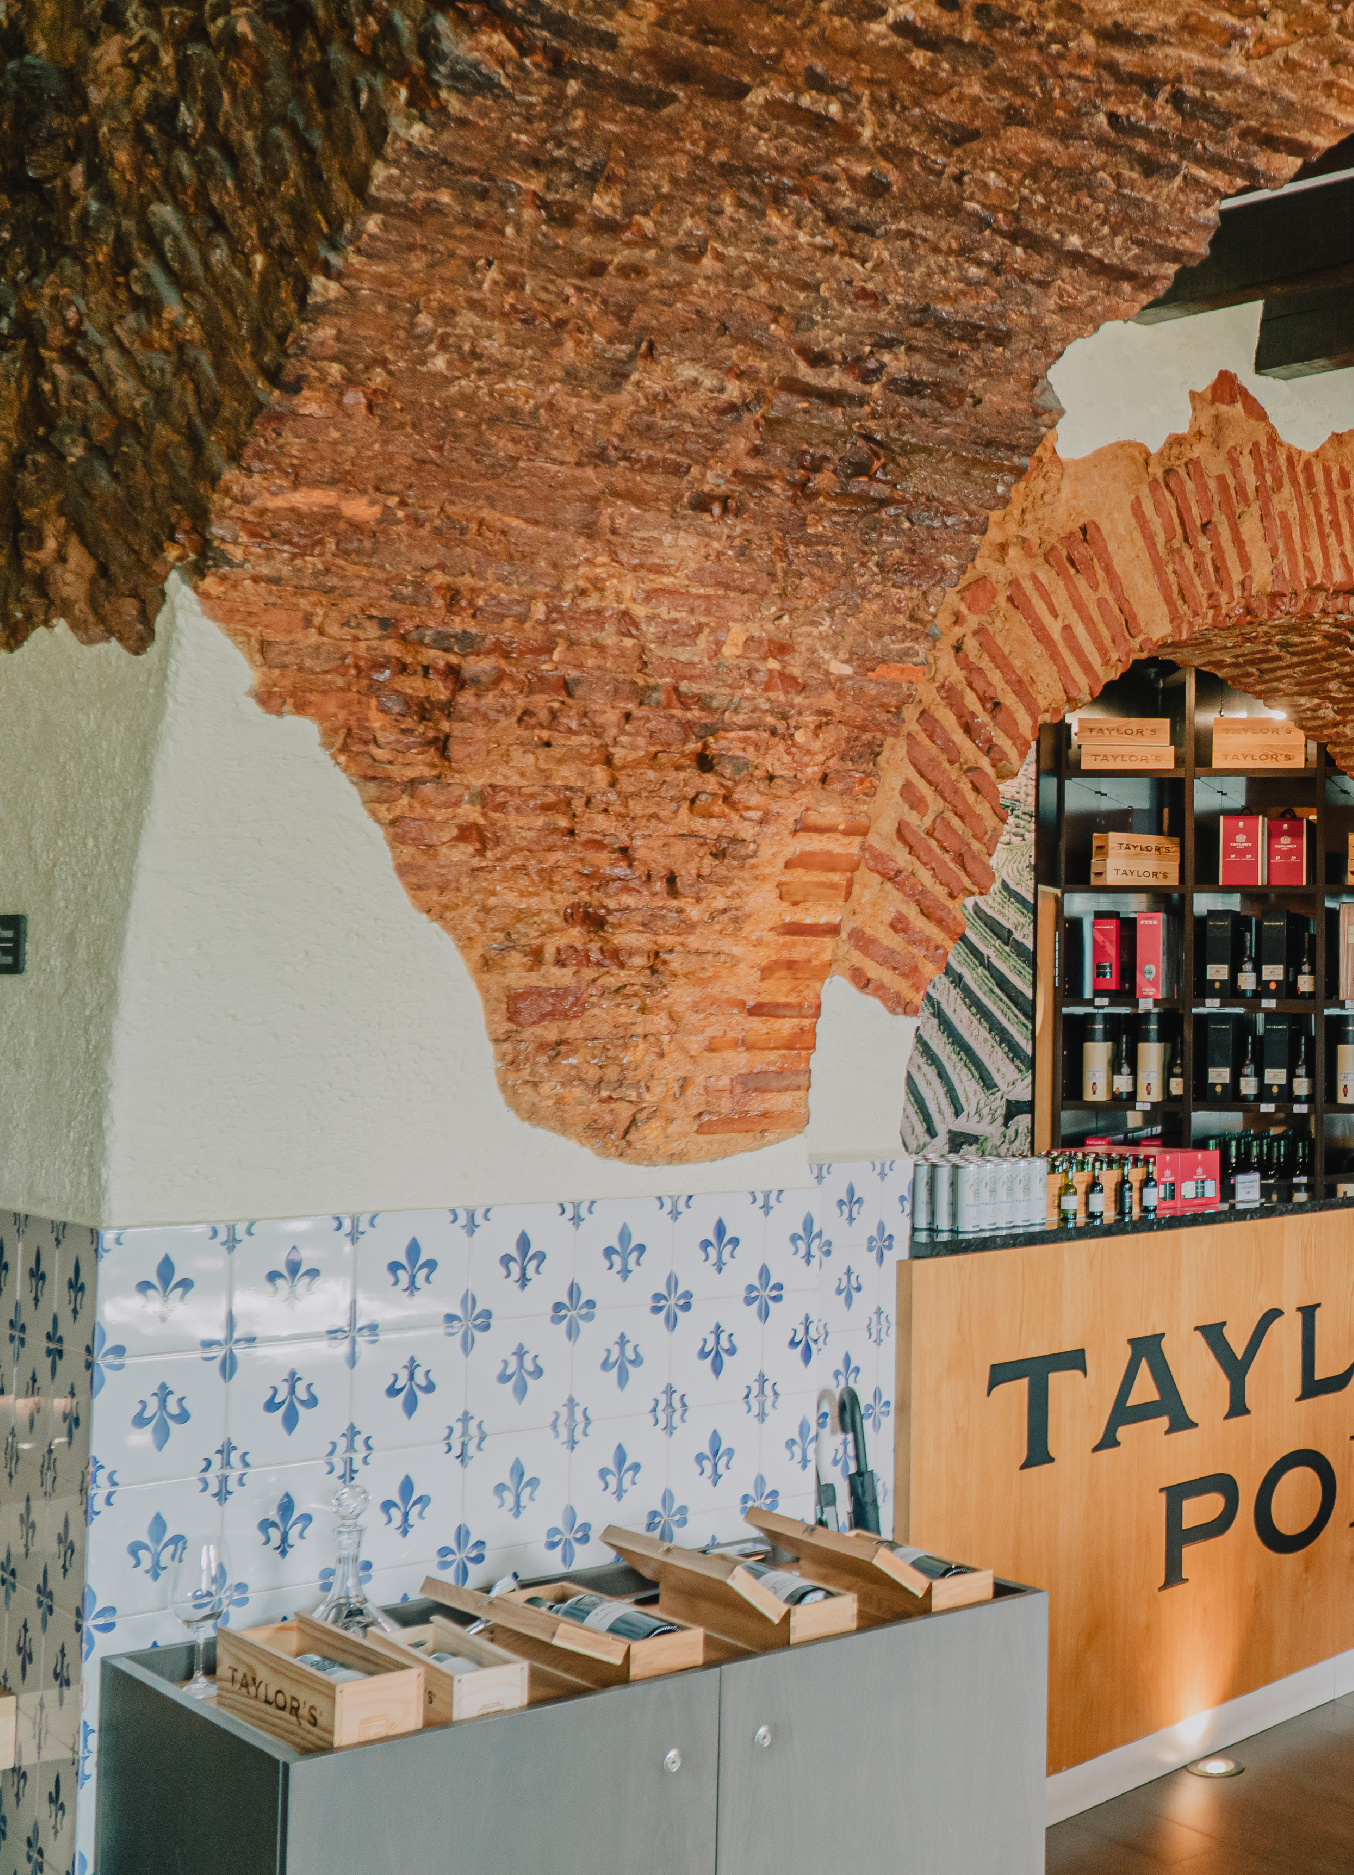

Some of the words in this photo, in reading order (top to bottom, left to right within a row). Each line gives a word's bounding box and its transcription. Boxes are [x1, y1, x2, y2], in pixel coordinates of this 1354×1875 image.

[1088, 727, 1156, 737] TAYLOR'S
[1091, 754, 1163, 763] TAYLOR'S
[1222, 752, 1293, 762] TAYLOR'S
[1117, 842, 1171, 854] TAYLOR'S
[1113, 868, 1169, 880] TAYLOR'S
[228, 1665, 320, 1728] TAYLOR'S
